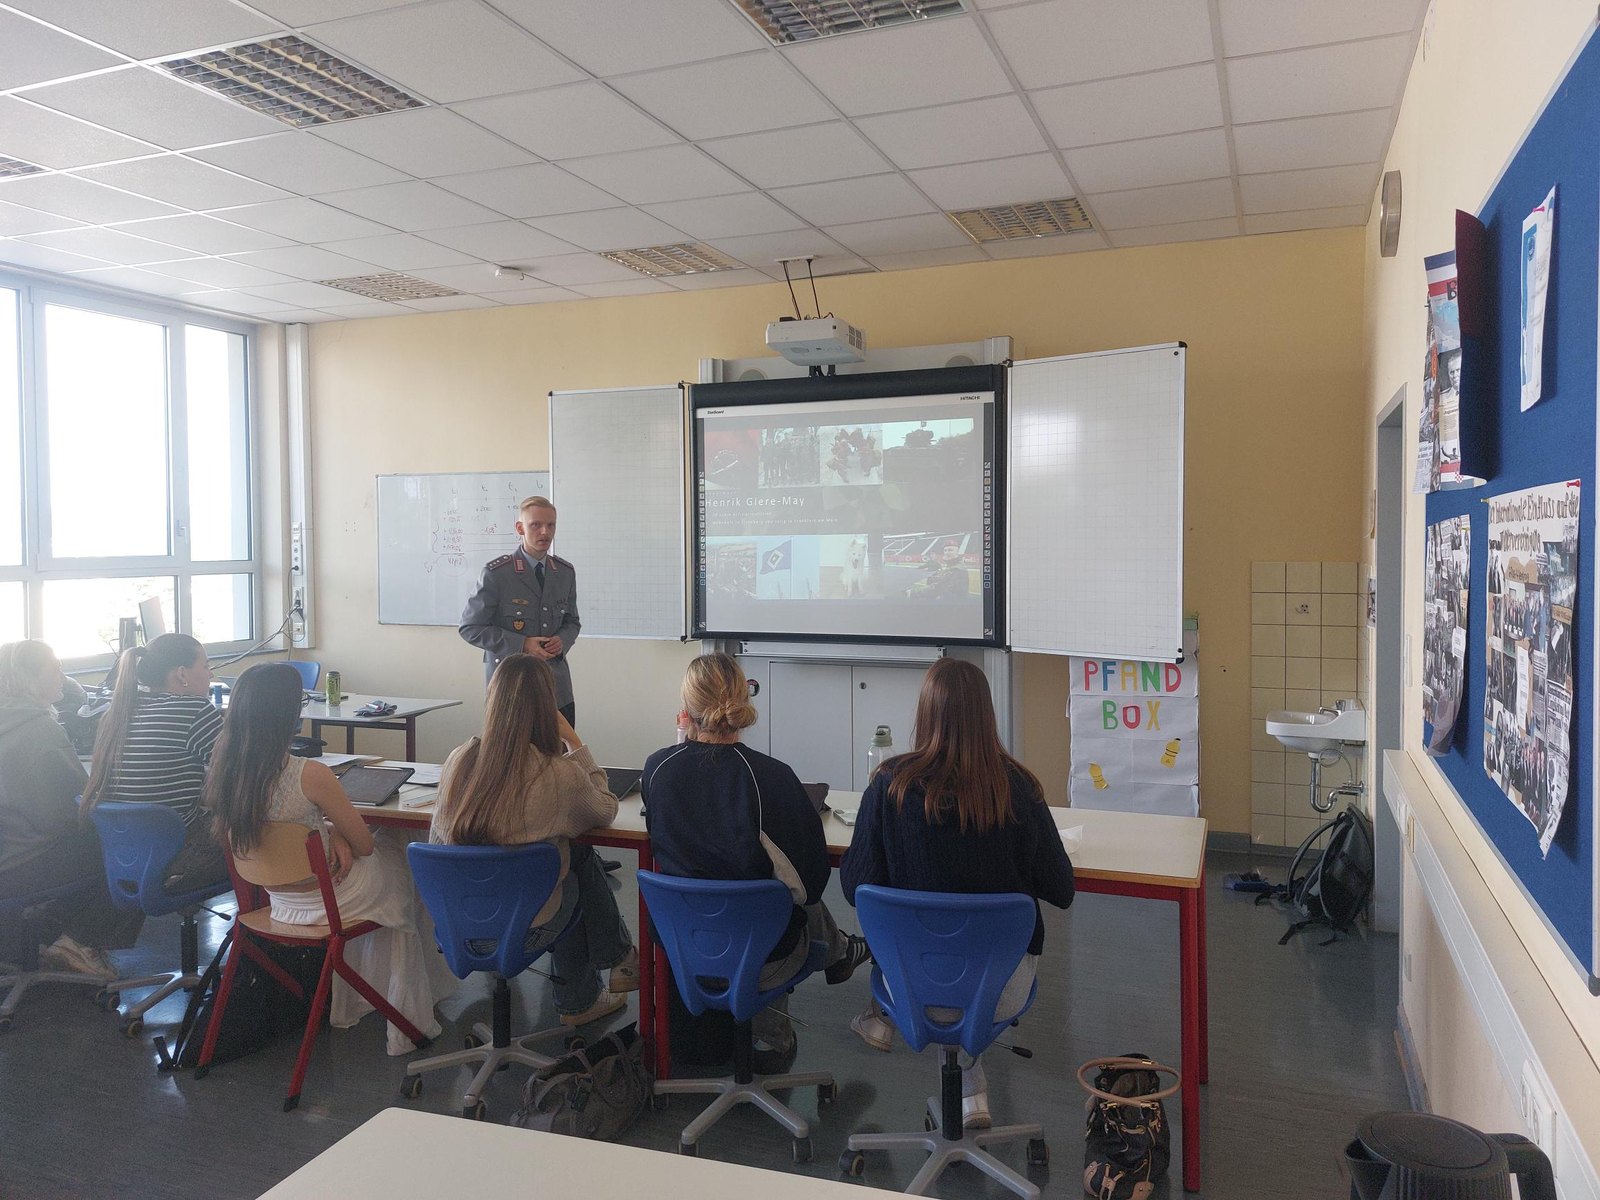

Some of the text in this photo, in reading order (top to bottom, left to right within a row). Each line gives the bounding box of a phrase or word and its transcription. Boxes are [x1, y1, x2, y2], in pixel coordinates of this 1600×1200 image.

[705, 497, 741, 508] Henrik
[1084, 660, 1182, 692] PFAND
[1102, 700, 1161, 731] BOX
